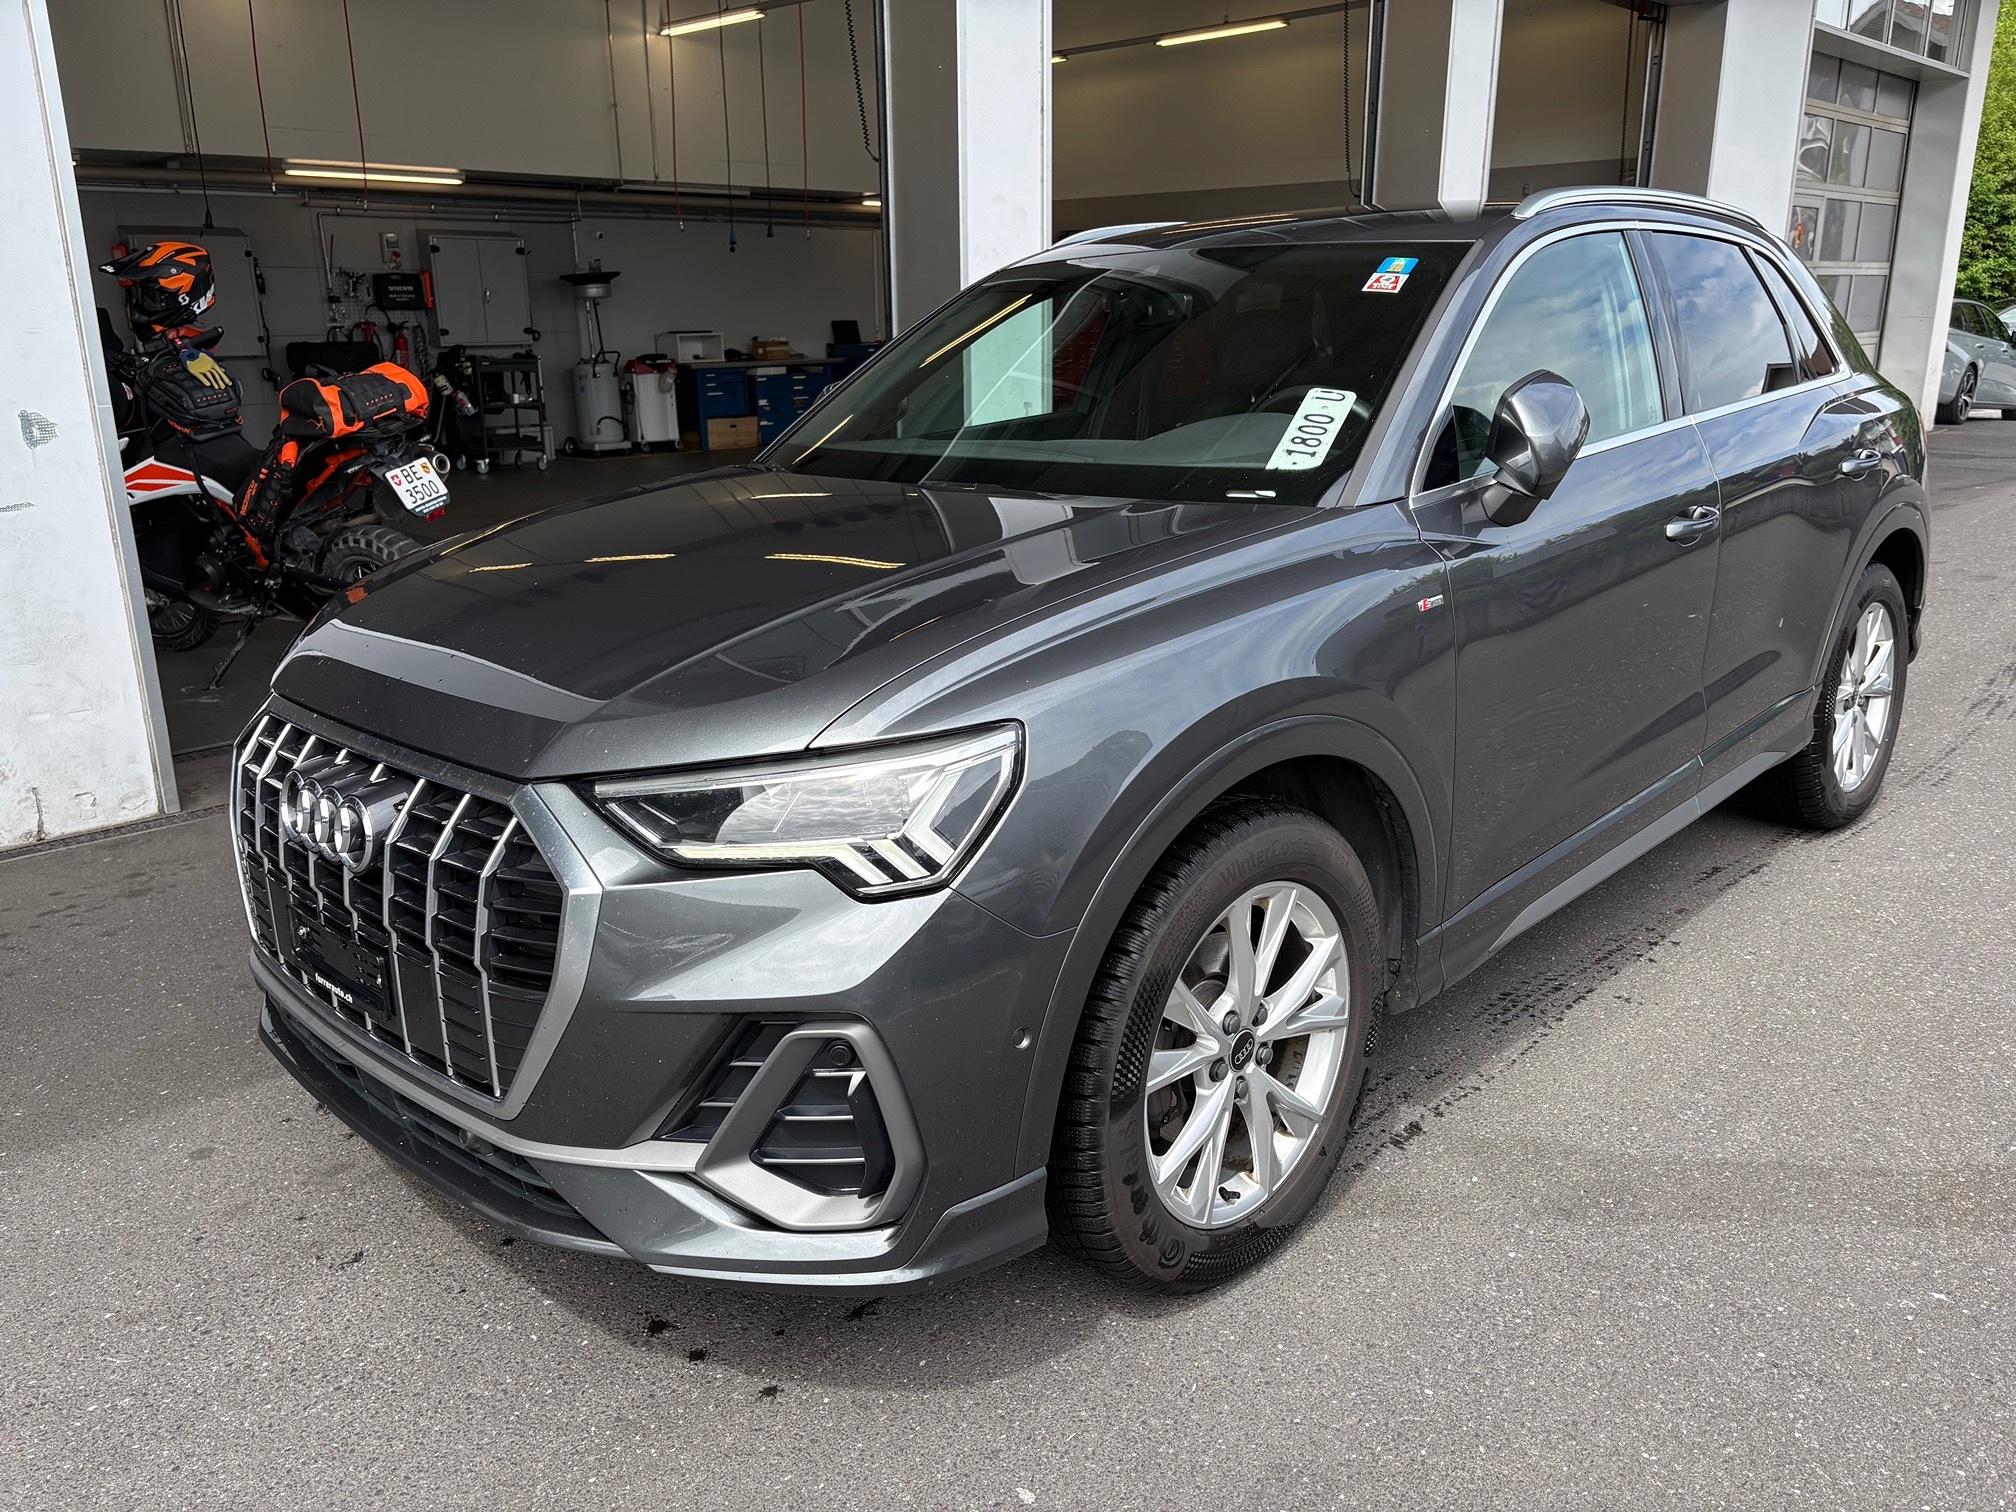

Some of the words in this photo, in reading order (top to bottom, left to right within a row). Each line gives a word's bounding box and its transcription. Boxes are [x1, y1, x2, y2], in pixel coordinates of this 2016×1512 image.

[1286, 413, 1334, 458] 1800
[1314, 390, 1346, 402] U
[400, 464, 423, 484] BE
[405, 480, 440, 504] 3500
